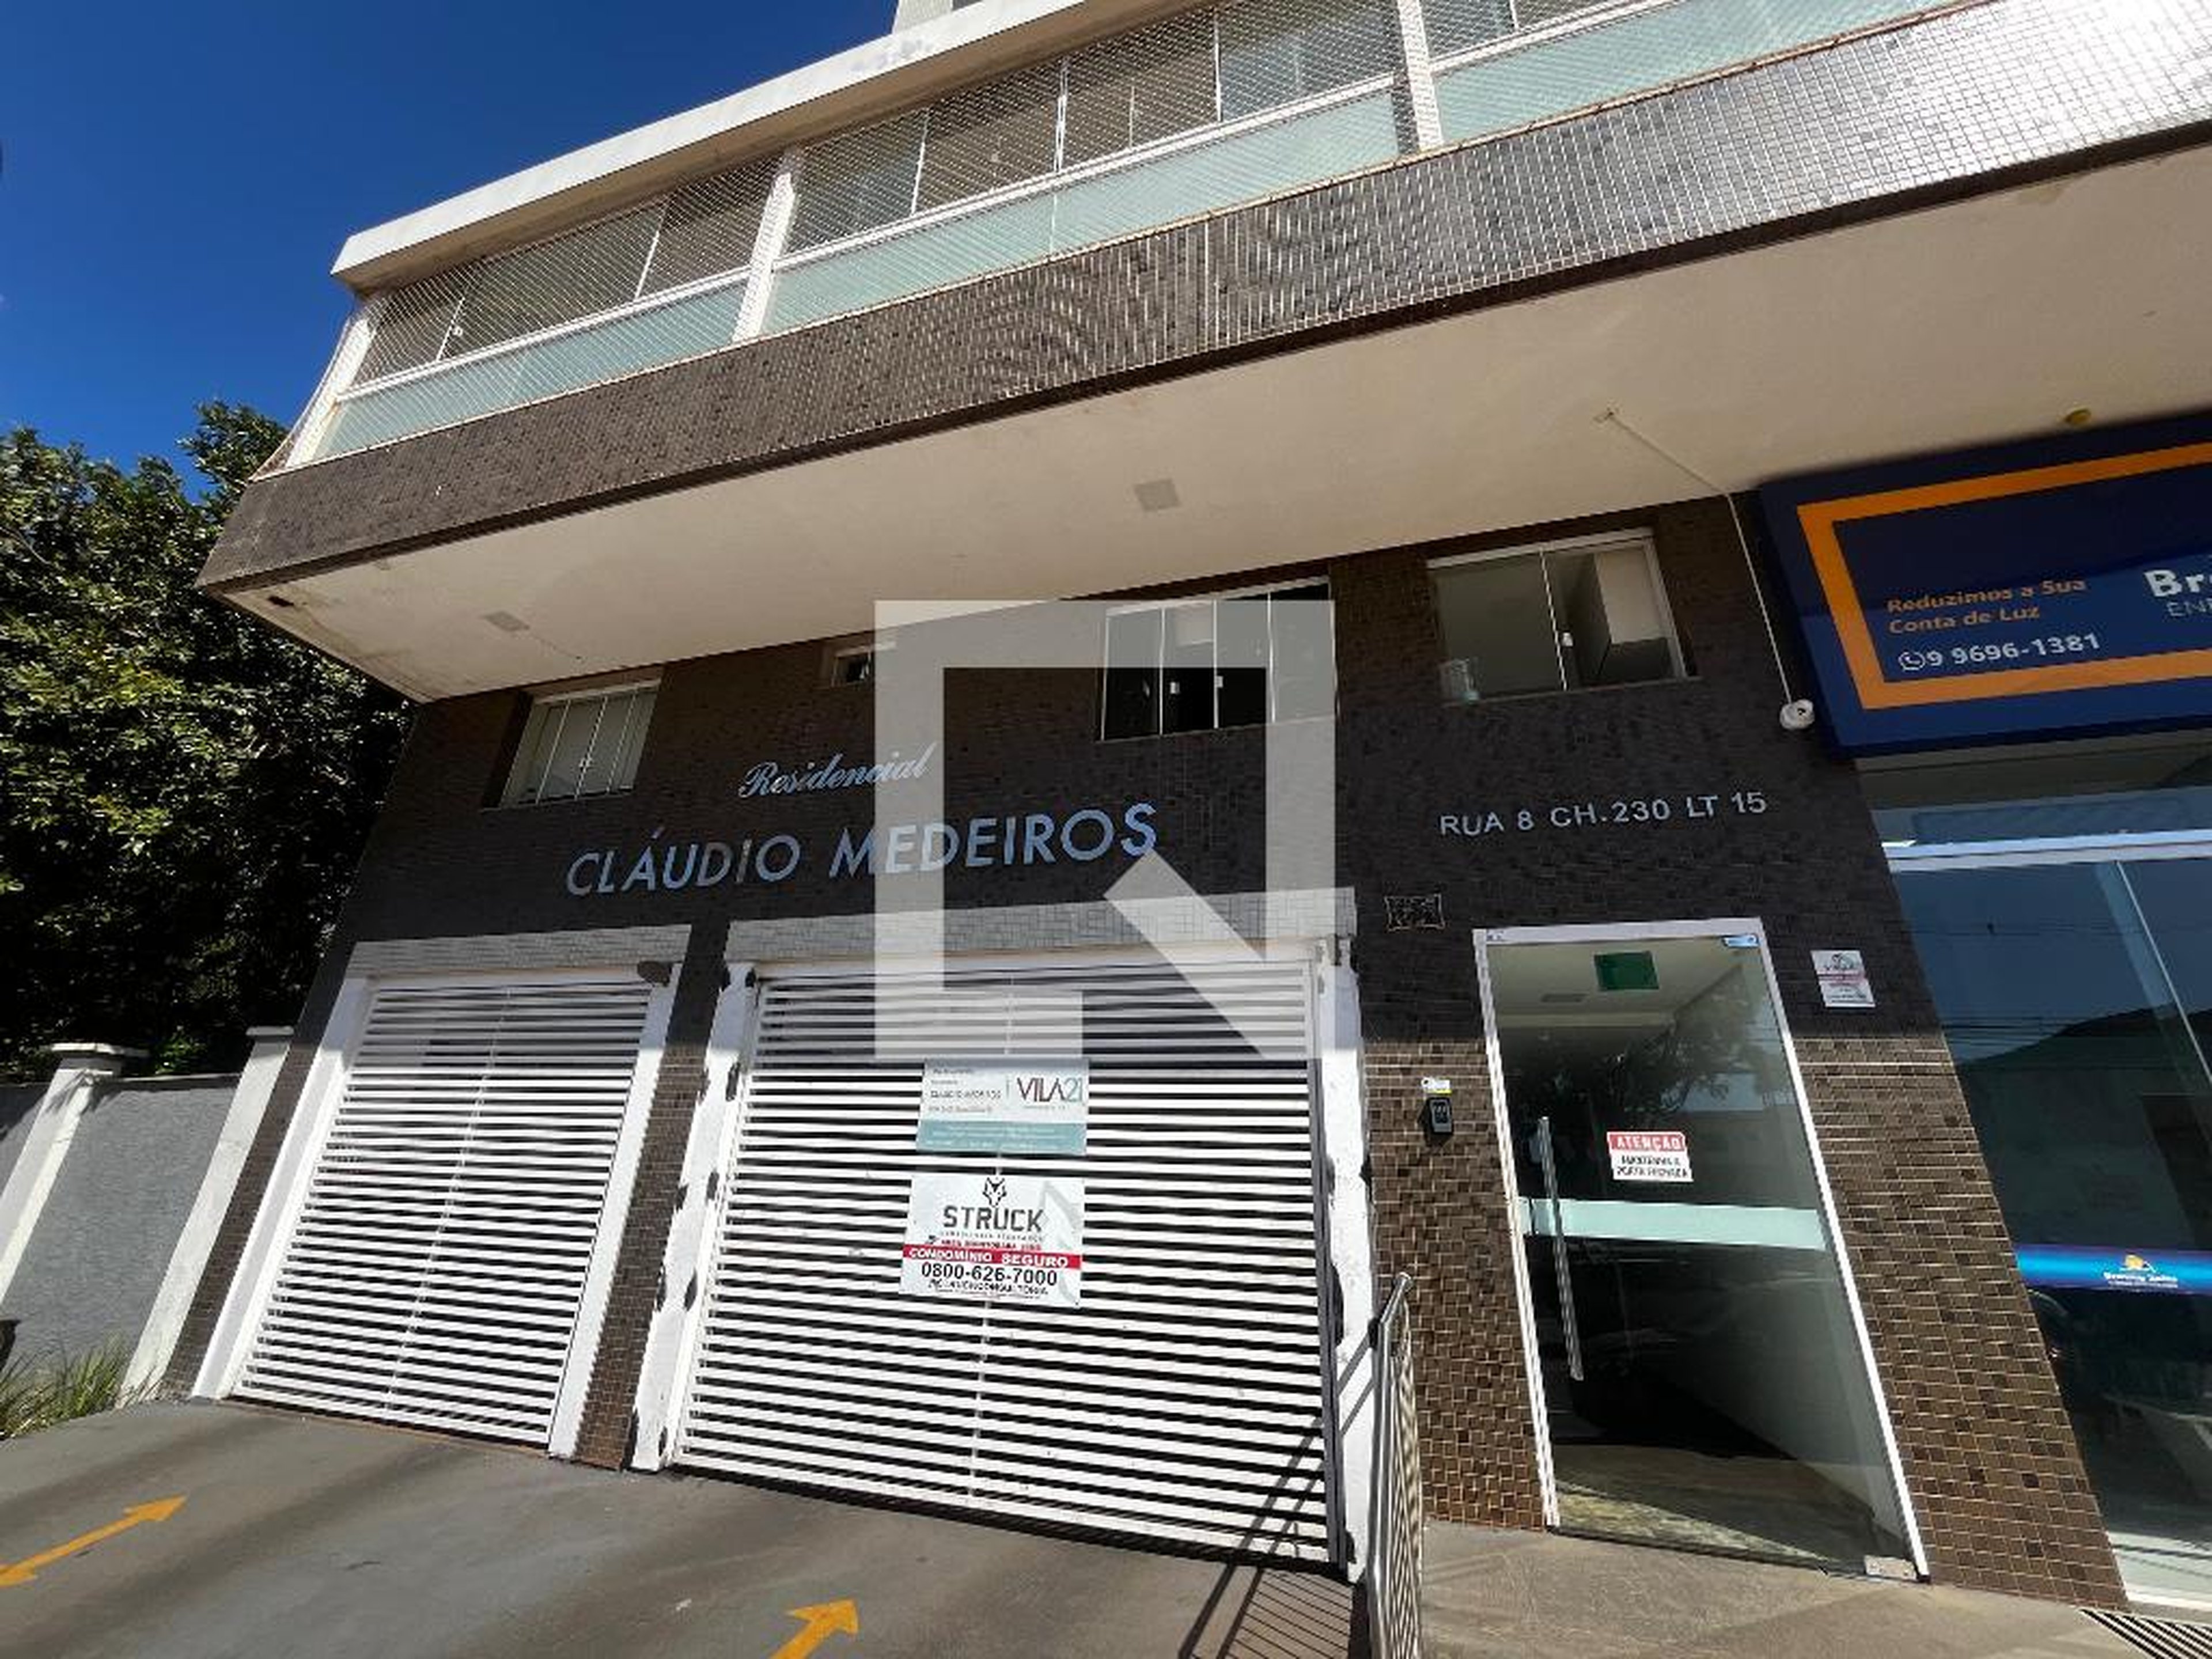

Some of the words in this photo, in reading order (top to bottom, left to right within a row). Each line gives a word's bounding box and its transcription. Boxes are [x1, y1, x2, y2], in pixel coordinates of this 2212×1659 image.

[1887, 587, 2012, 612] Reduzimos
[2021, 587, 2033, 597] a
[2042, 579, 2086, 595] Sua
[2143, 569, 2212, 597] Br
[1889, 618, 1956, 634] Conta
[1964, 611, 1992, 626] de
[1999, 605, 2040, 621] Luz
[1927, 651, 1943, 666] 9
[1952, 632, 2101, 665] 9696-1381
[738, 741, 935, 798] Residencial
[1440, 810, 1505, 836] RUA
[1517, 810, 1534, 831] 8
[1550, 798, 1671, 828] CH.230
[1685, 795, 1718, 817] LT
[1731, 791, 1767, 813] 15
[565, 825, 801, 896] CLÁUDIO
[828, 802, 1158, 878] MEDEIROS
[942, 1205, 1044, 1233] STRUCK
[921, 1260, 1058, 1286] 0800-626-7000
[1001, 1254, 1069, 1267] SEGURO
